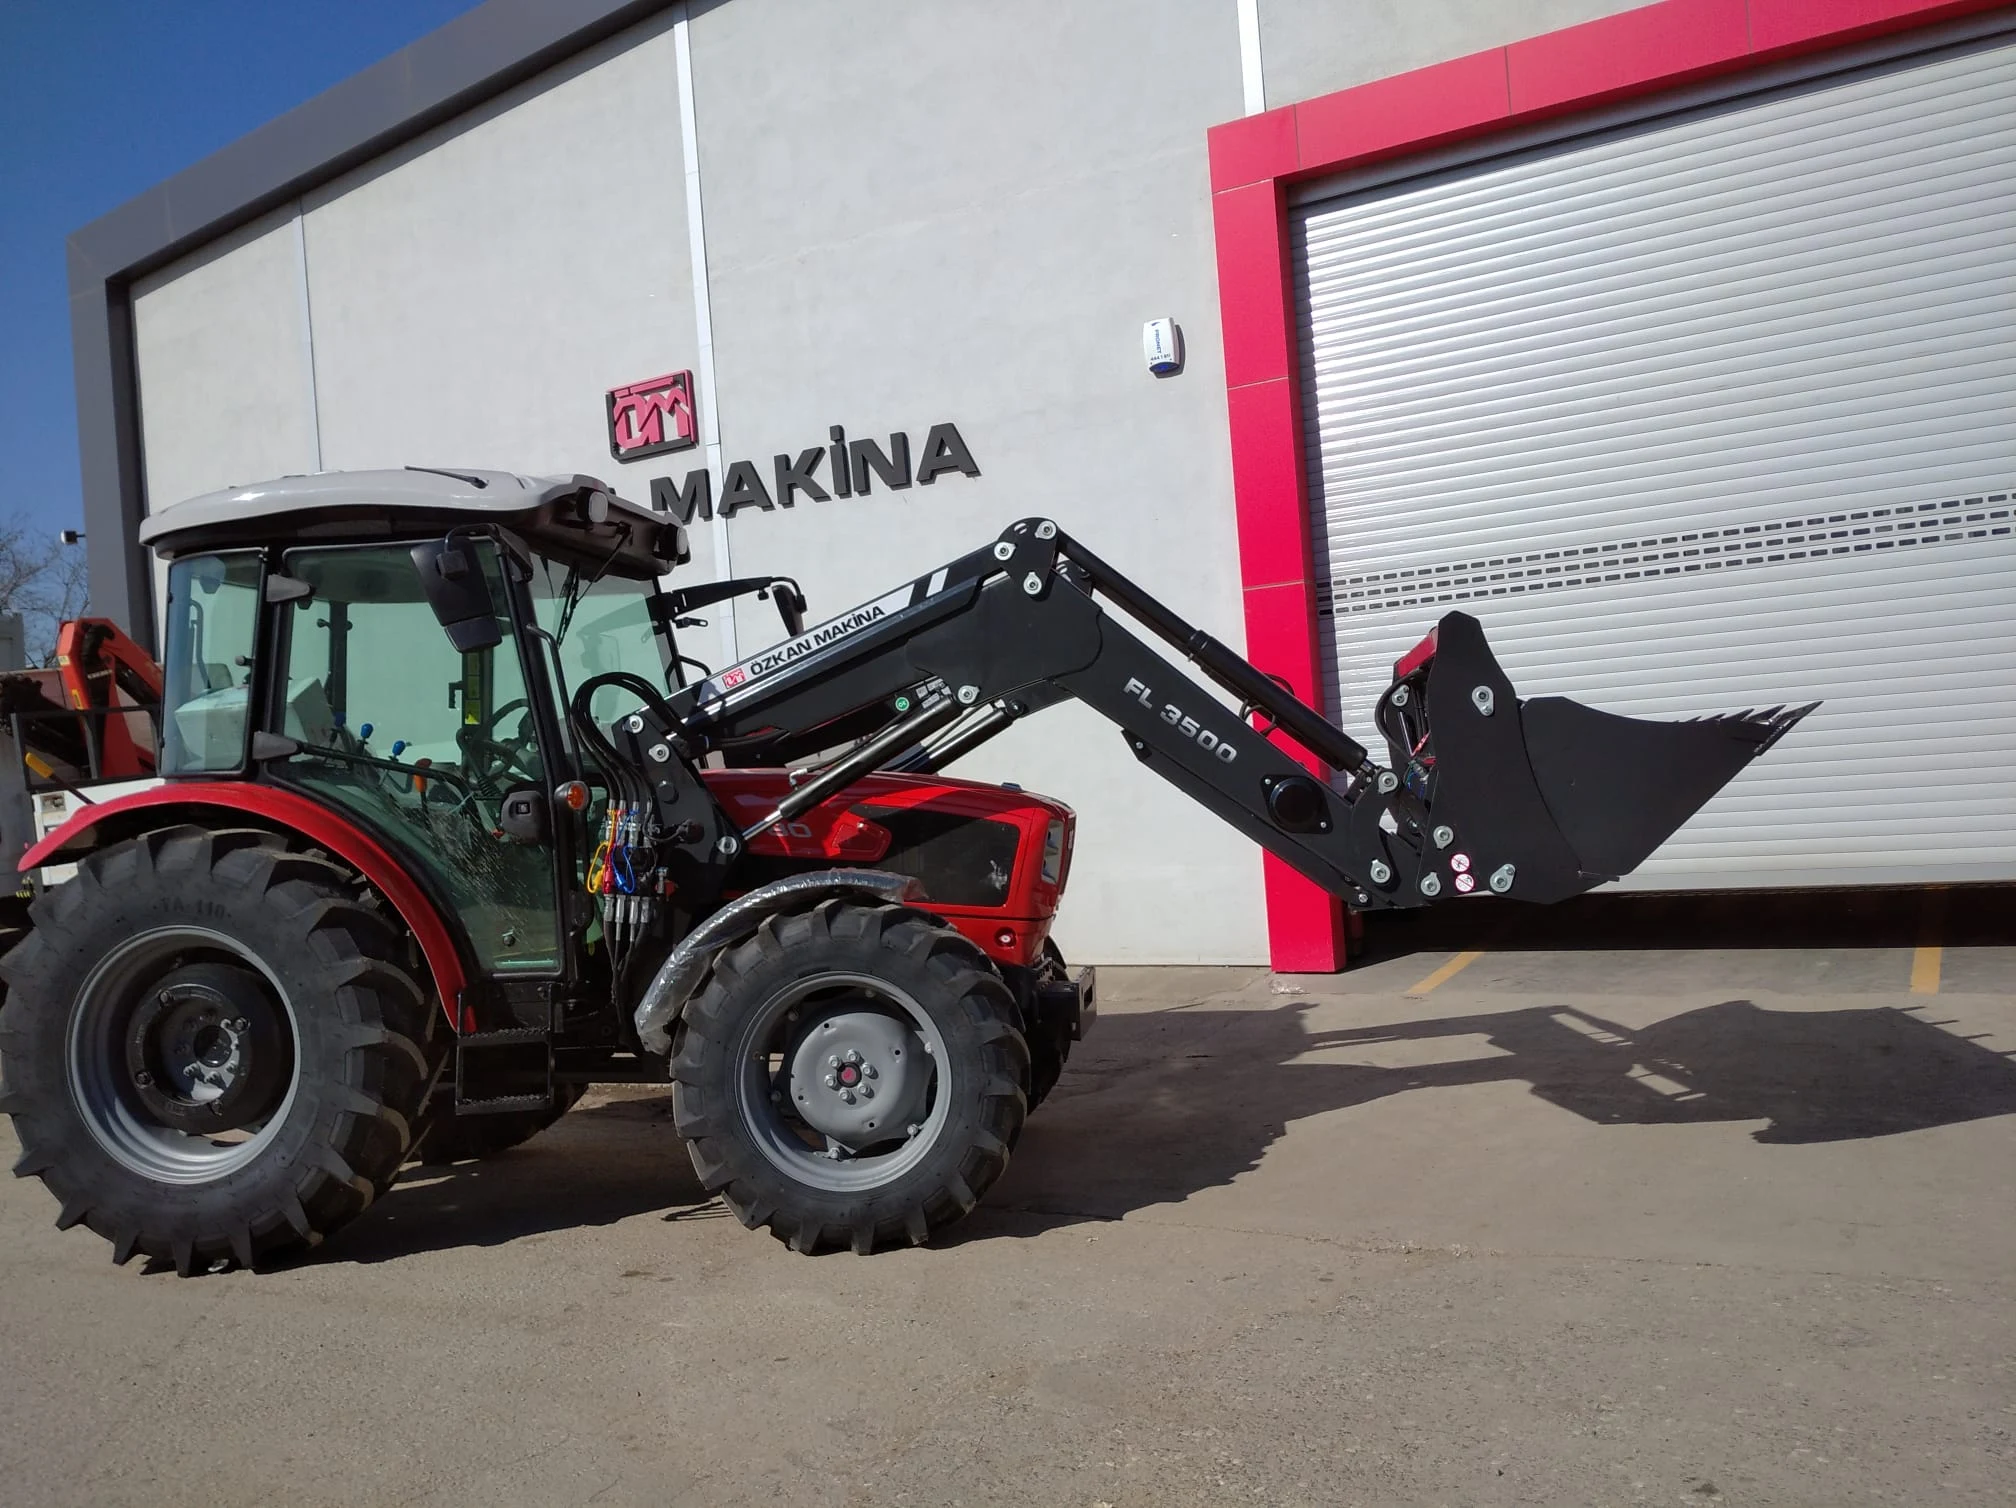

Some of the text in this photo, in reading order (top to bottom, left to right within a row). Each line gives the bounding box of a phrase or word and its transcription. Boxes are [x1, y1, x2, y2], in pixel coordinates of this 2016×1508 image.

[650, 422, 982, 526] MAKİNA
[750, 641, 812, 676] ÖZKAN
[815, 605, 885, 646] MAKİNA
[1123, 677, 1237, 763] FL 3500
